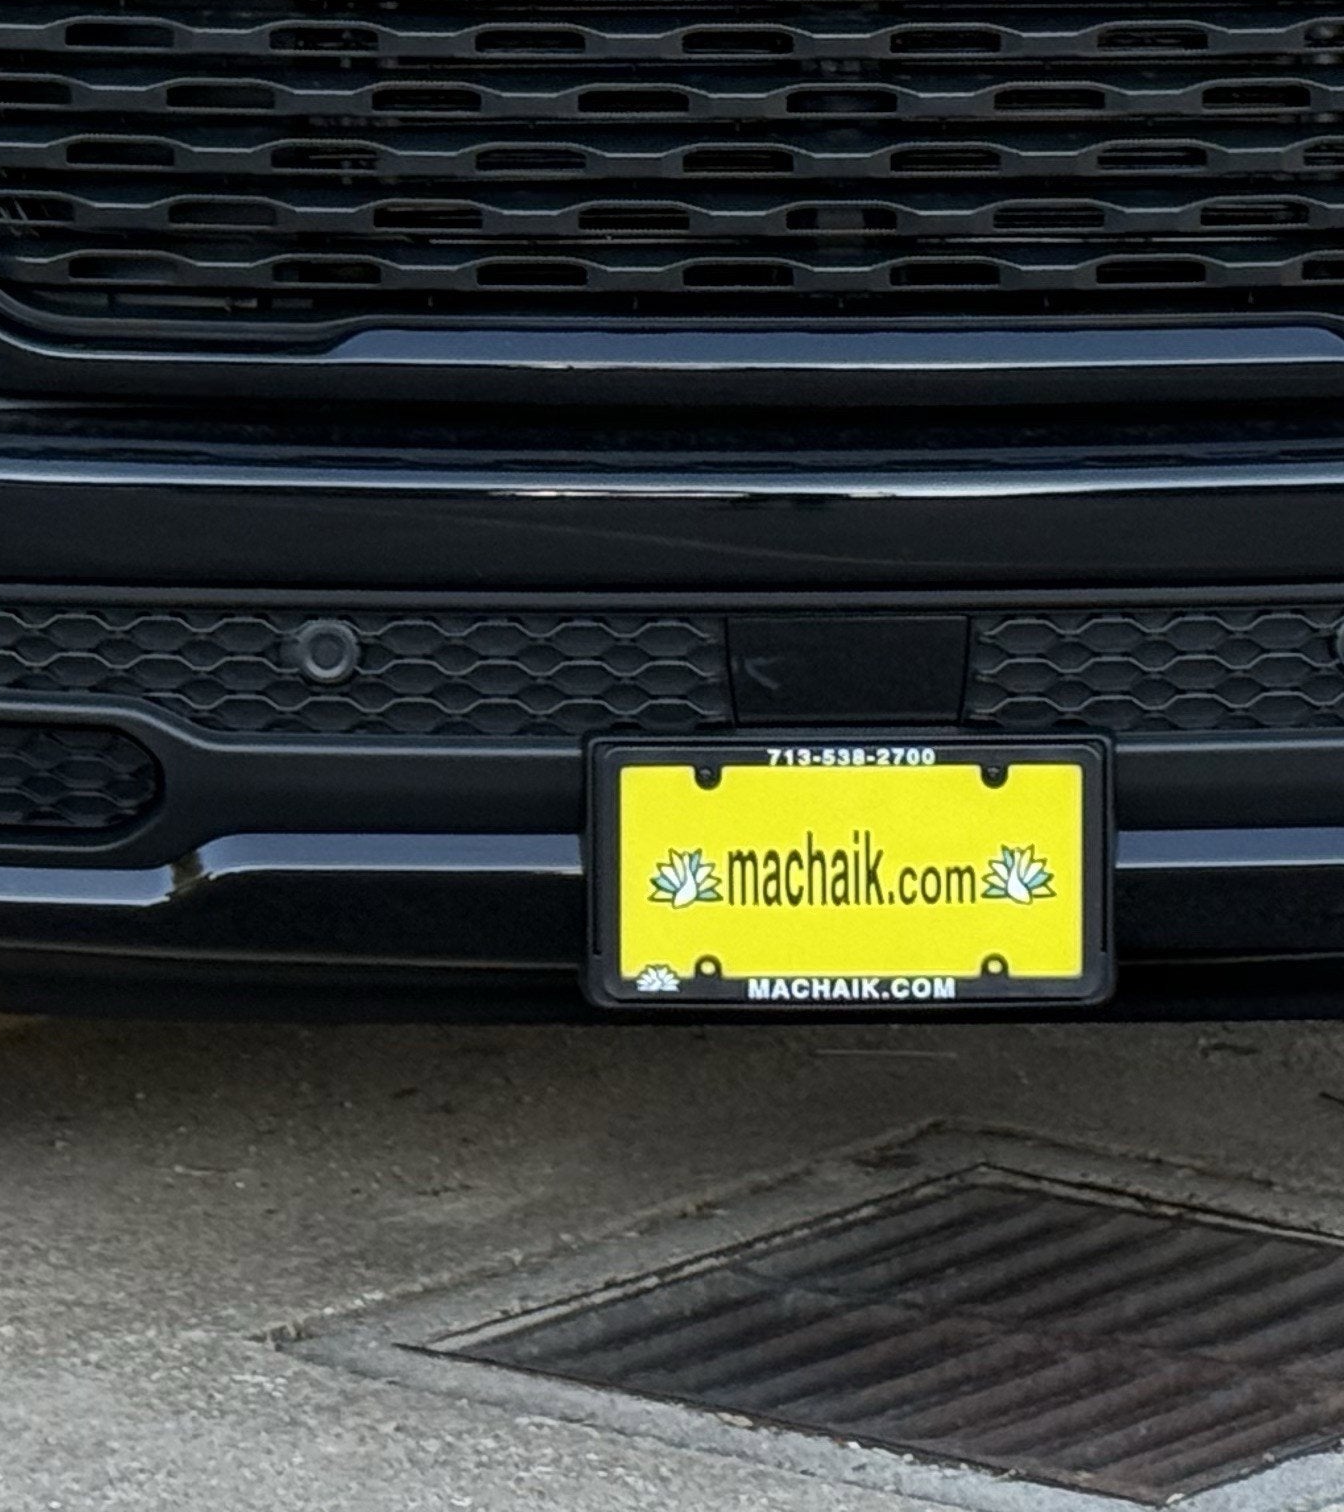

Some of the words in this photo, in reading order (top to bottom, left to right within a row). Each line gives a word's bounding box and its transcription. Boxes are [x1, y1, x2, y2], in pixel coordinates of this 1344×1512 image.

[767, 748, 936, 766] 713-538-2700
[728, 830, 976, 906] machaik.com
[749, 978, 956, 999] MACHAIK.COM
